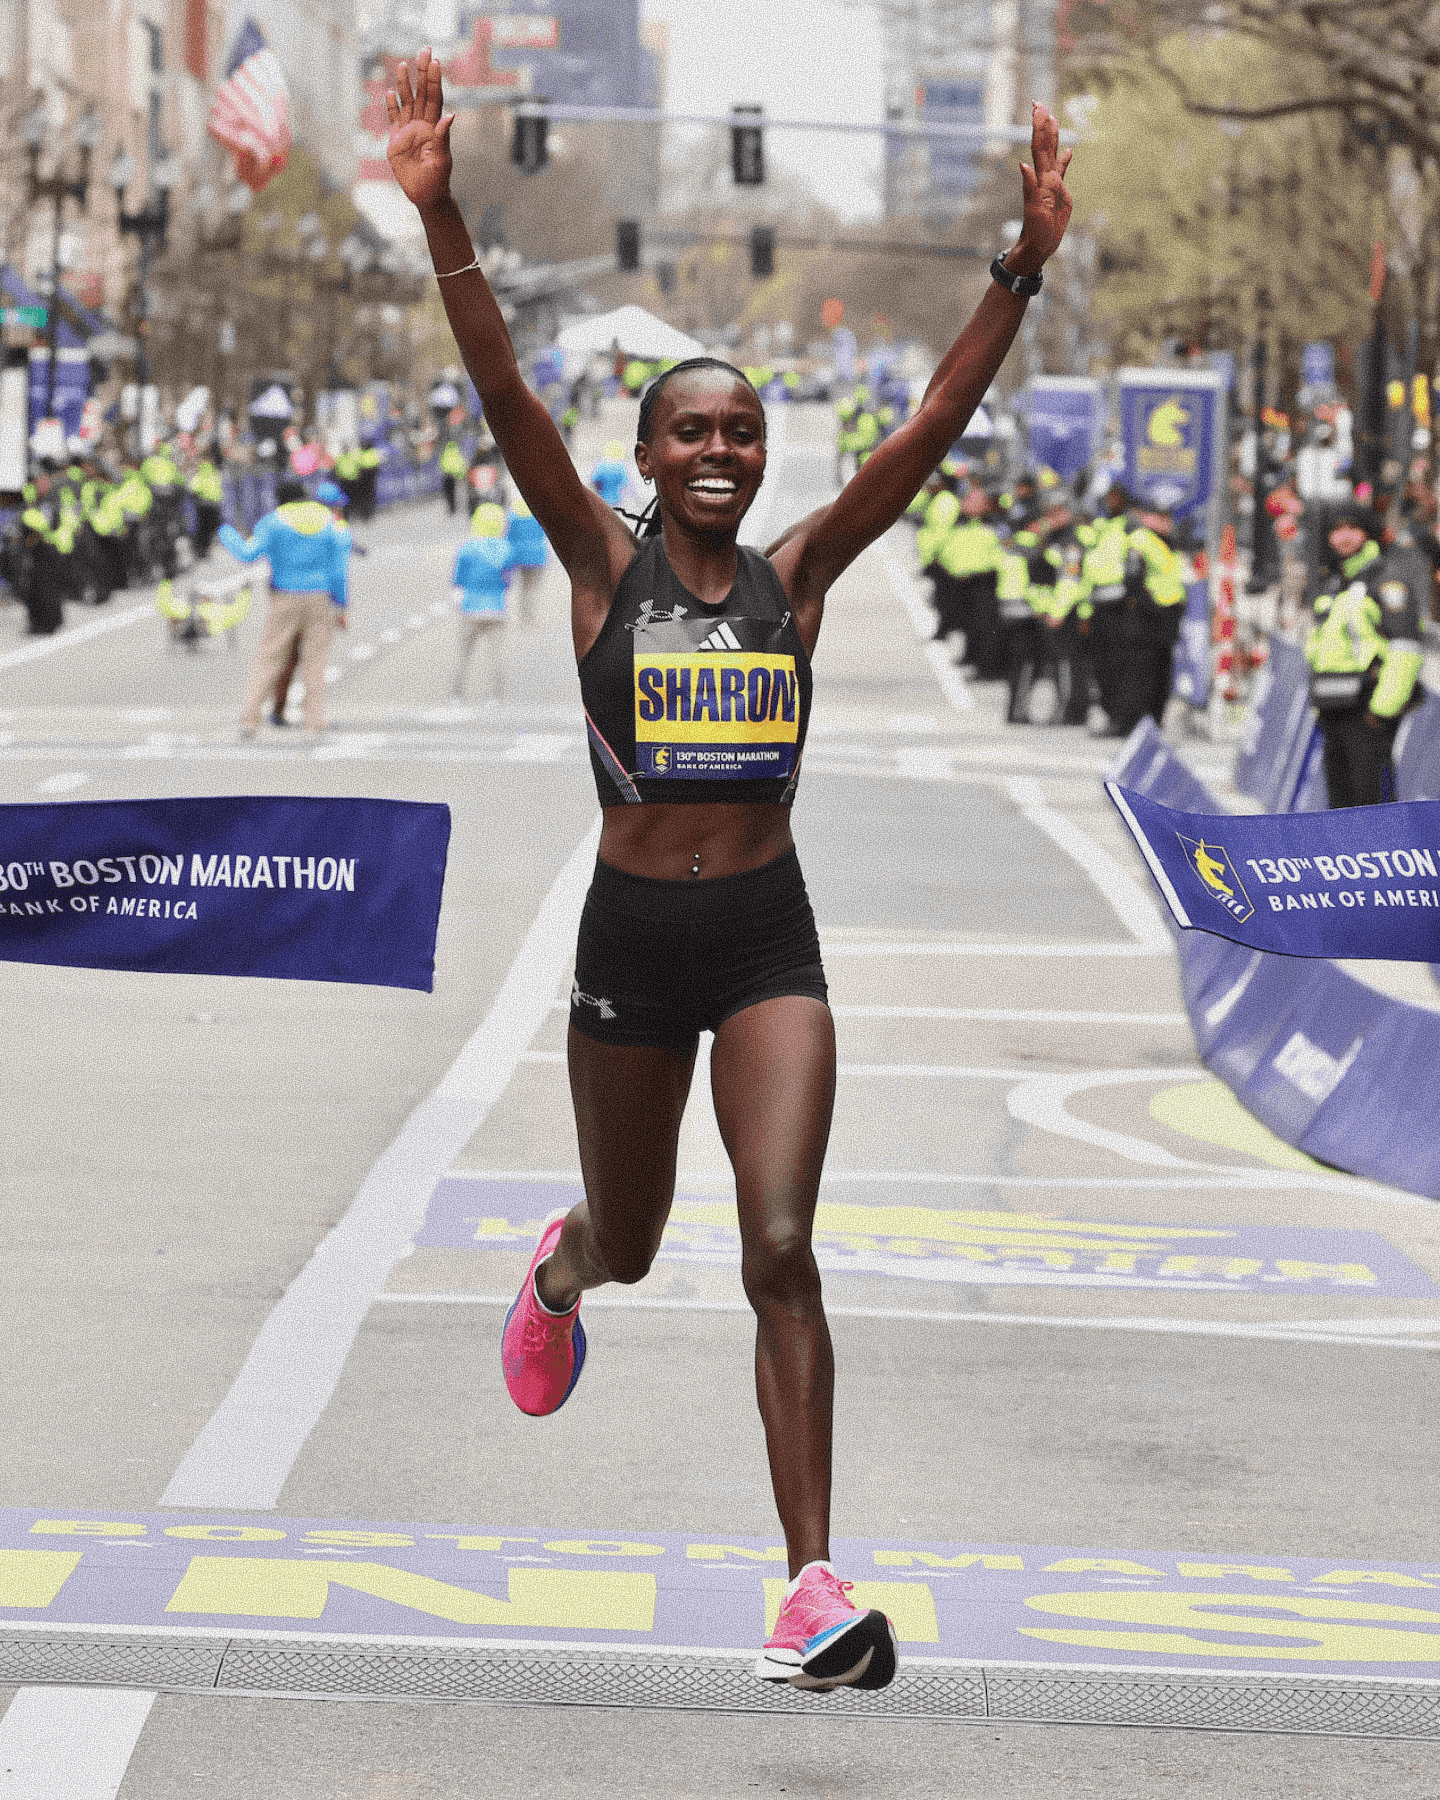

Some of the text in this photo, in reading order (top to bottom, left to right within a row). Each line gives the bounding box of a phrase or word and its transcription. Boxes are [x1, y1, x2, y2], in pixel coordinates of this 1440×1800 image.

[638, 667, 796, 722] SHARON
[697, 751, 736, 761] BOSTON
[737, 751, 780, 761] MARATHON
[49, 854, 184, 888] BOSTON
[190, 854, 355, 892] MARATHON
[1246, 848, 1438, 884] 130TH BOSTON
[70, 895, 100, 913] OF
[106, 896, 198, 920] AMERICA
[1268, 890, 1439, 912] BANK OF AMERI
[29, 1519, 1440, 1589] BOSTON MARA
